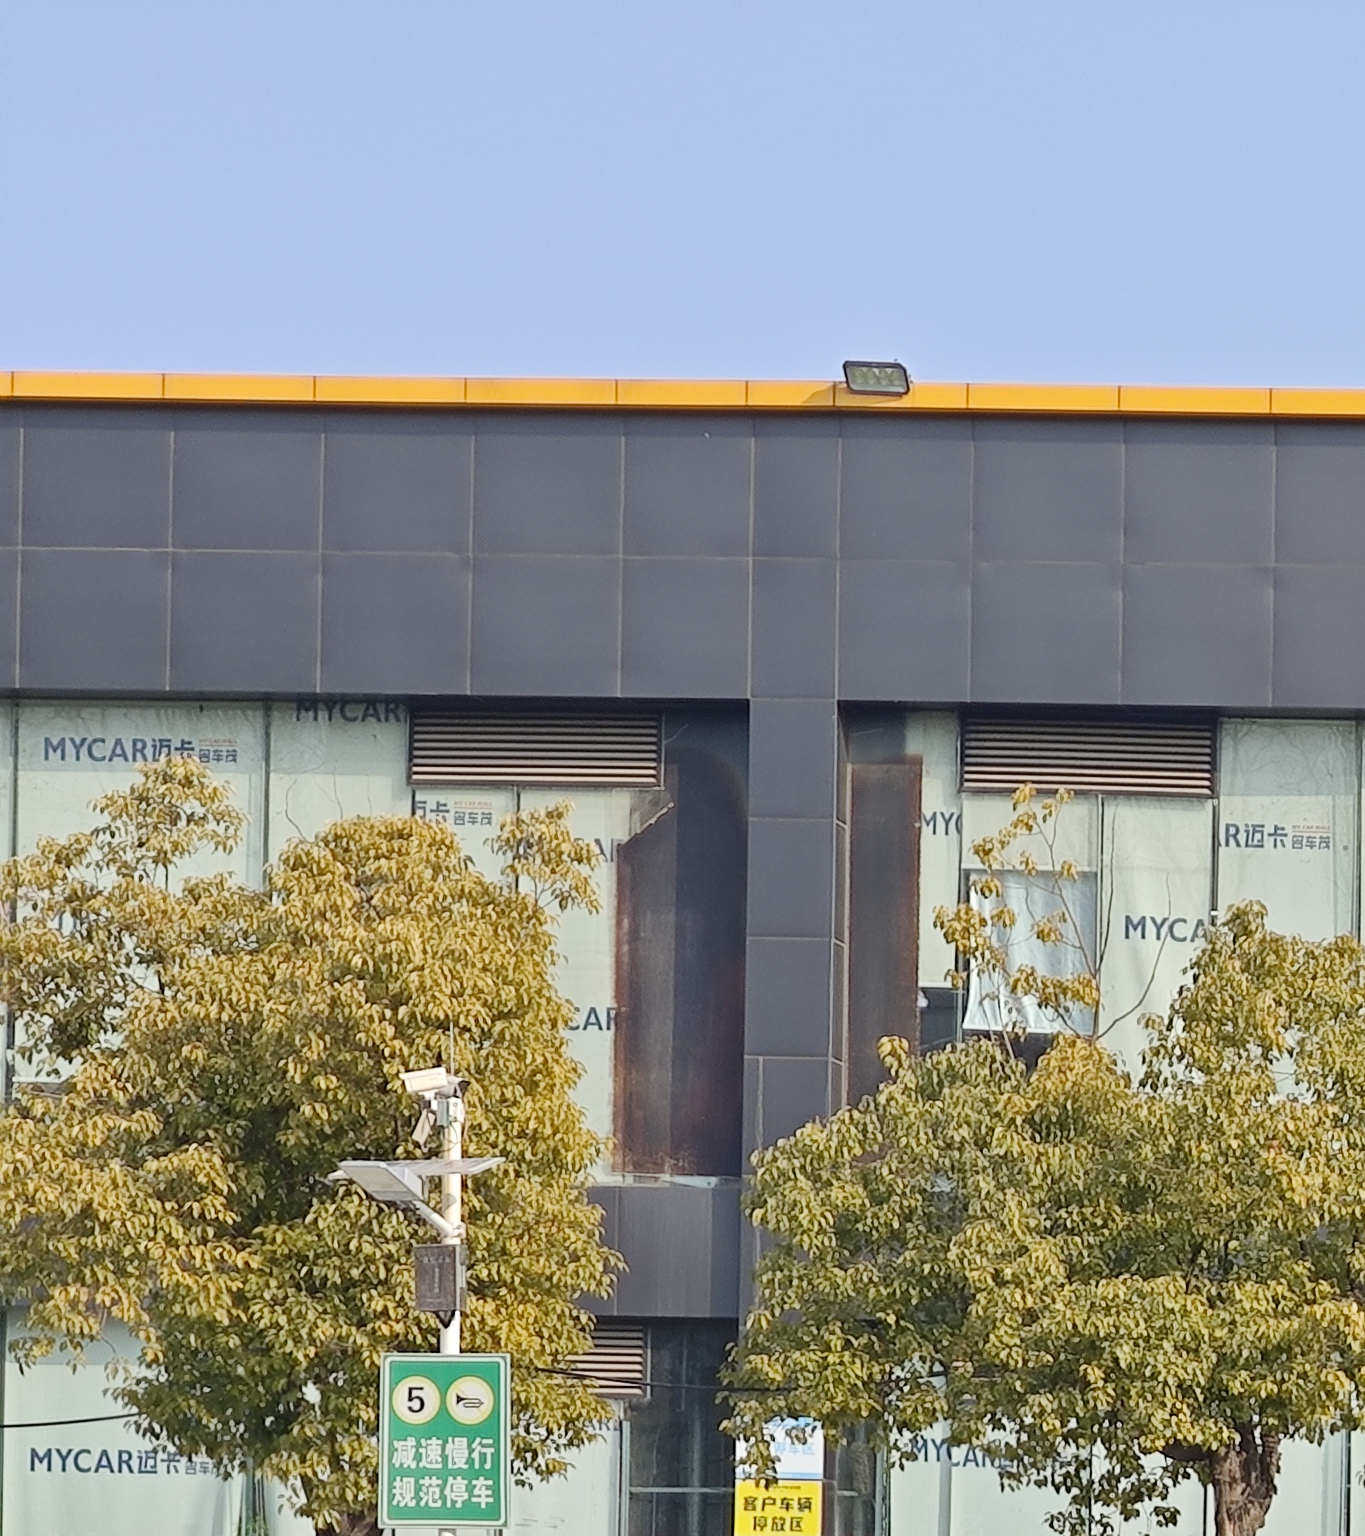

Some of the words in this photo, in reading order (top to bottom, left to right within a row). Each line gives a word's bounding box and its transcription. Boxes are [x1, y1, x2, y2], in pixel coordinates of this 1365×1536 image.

[406, 1387, 425, 1413] 5
[391, 1437, 495, 1470] 减速慢行
[391, 1476, 495, 1509] 规范停车
